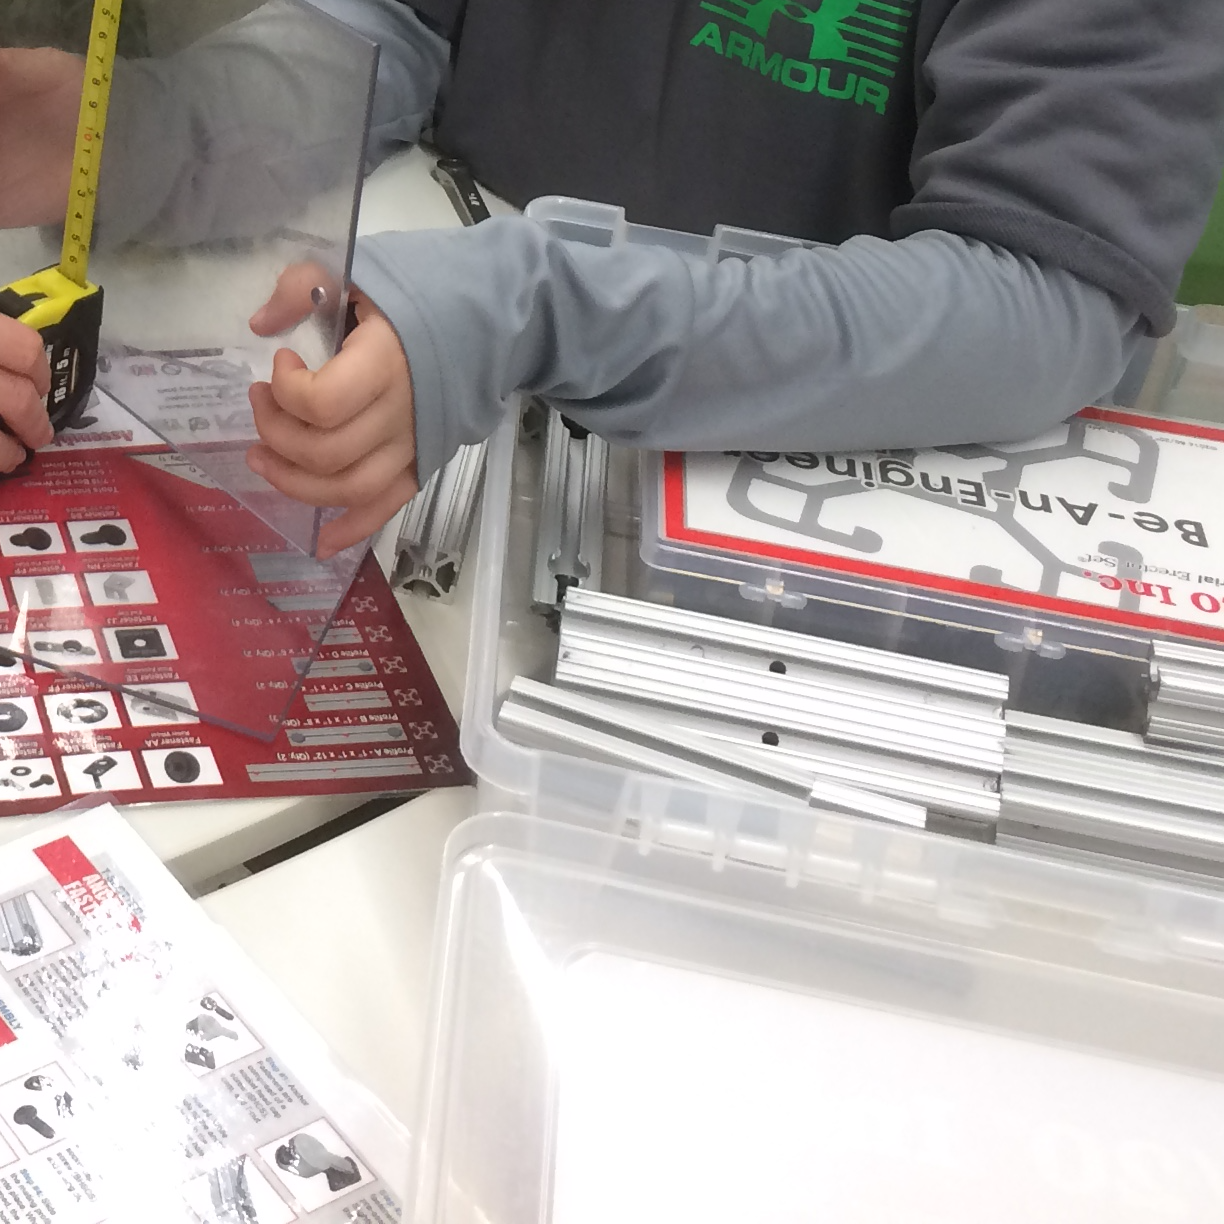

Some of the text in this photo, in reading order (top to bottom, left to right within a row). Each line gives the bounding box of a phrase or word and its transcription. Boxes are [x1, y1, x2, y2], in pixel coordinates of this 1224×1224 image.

[689, 21, 890, 116] ARMOUR
[53, 386, 67, 404] 16
[1084, 569, 1178, 606] Inc.
[143, 735, 202, 748] Fastener AA
[276, 751, 288, 762] 2)
[373, 747, 381, 756] A
[382, 746, 414, 756] Profile
